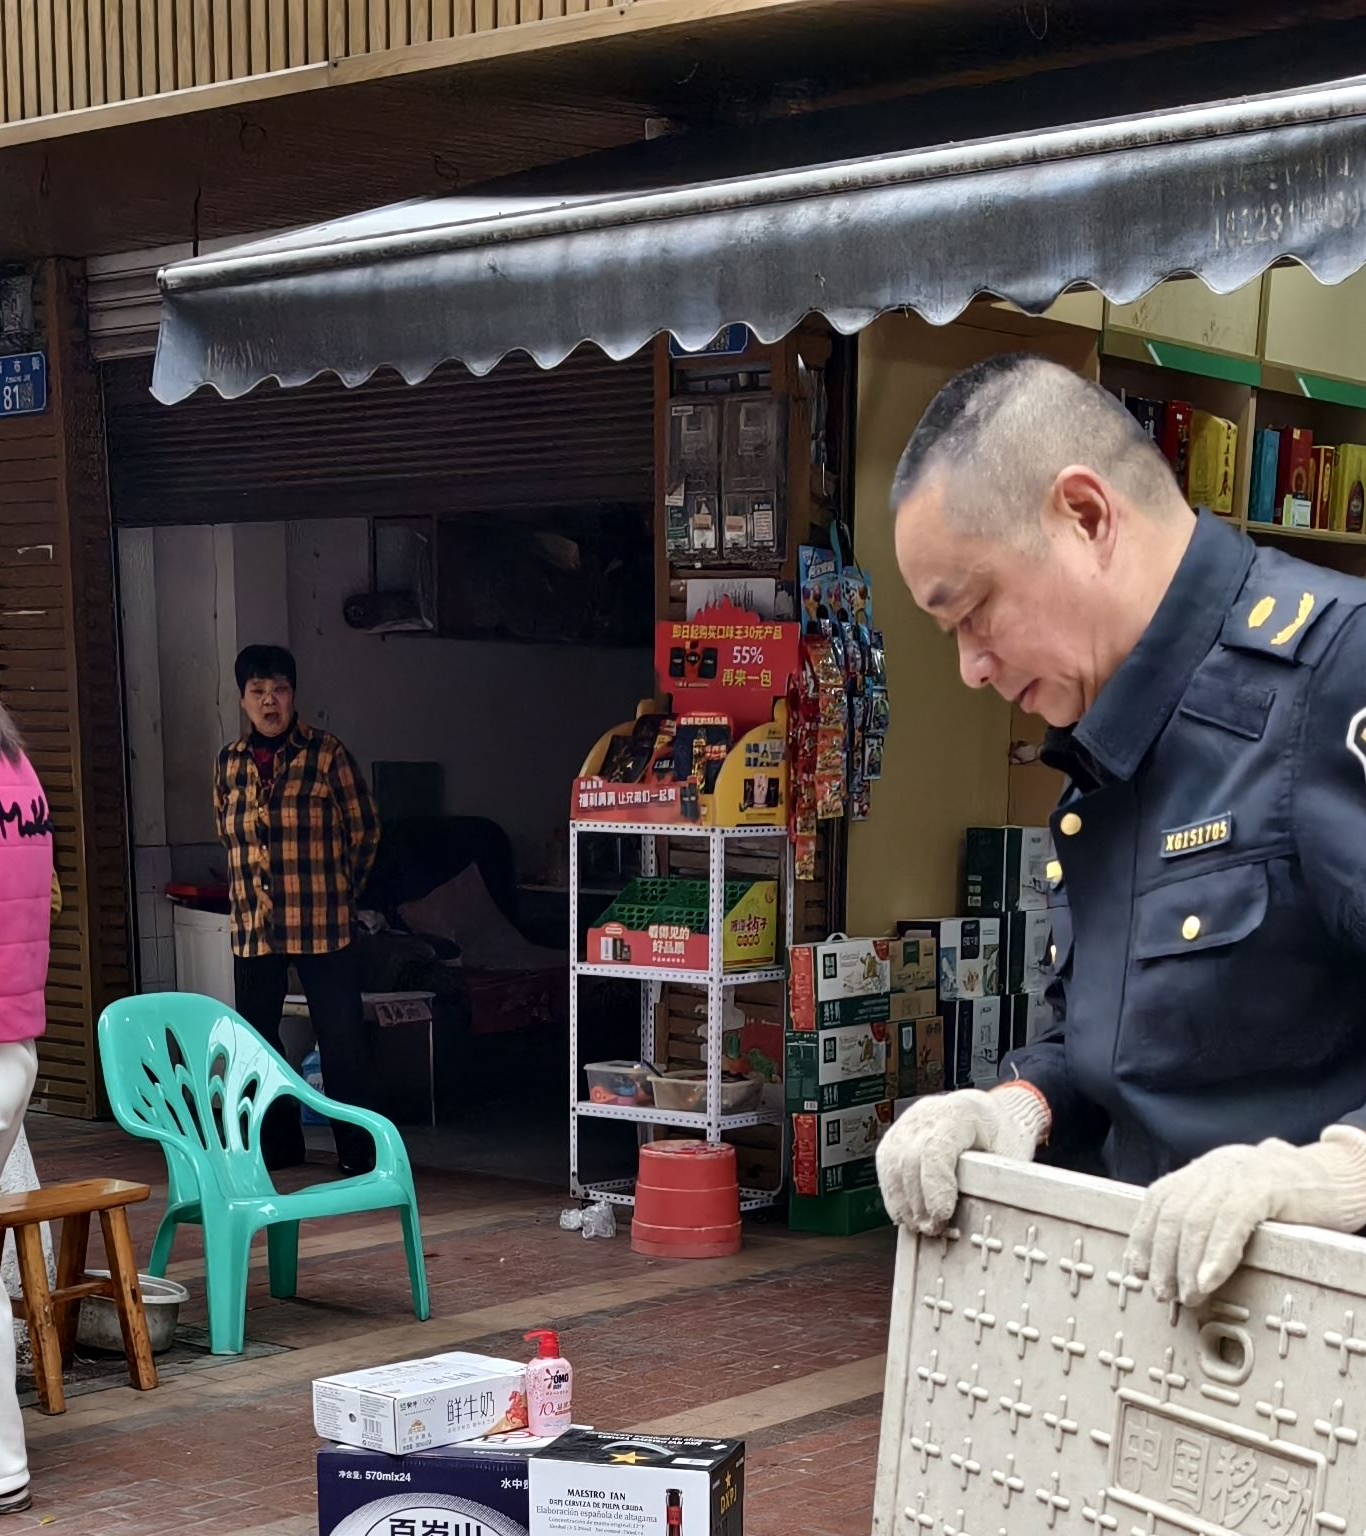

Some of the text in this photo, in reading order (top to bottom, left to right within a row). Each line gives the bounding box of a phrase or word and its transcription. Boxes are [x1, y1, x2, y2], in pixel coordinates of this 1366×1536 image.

[3, 384, 19, 411] 81
[732, 645, 764, 665] 55%
[722, 668, 772, 688] 再来一包
[1165, 820, 1227, 851] XG151705
[447, 1391, 495, 1426] 鲜牛奶
[567, 1488, 606, 1499] MAESTRO
[536, 1505, 579, 1517] Elaboración
[580, 1509, 613, 1519] española
[613, 1511, 623, 1520] de
[564, 1500, 591, 1508] CERVEZA
[592, 1501, 601, 1509] DE
